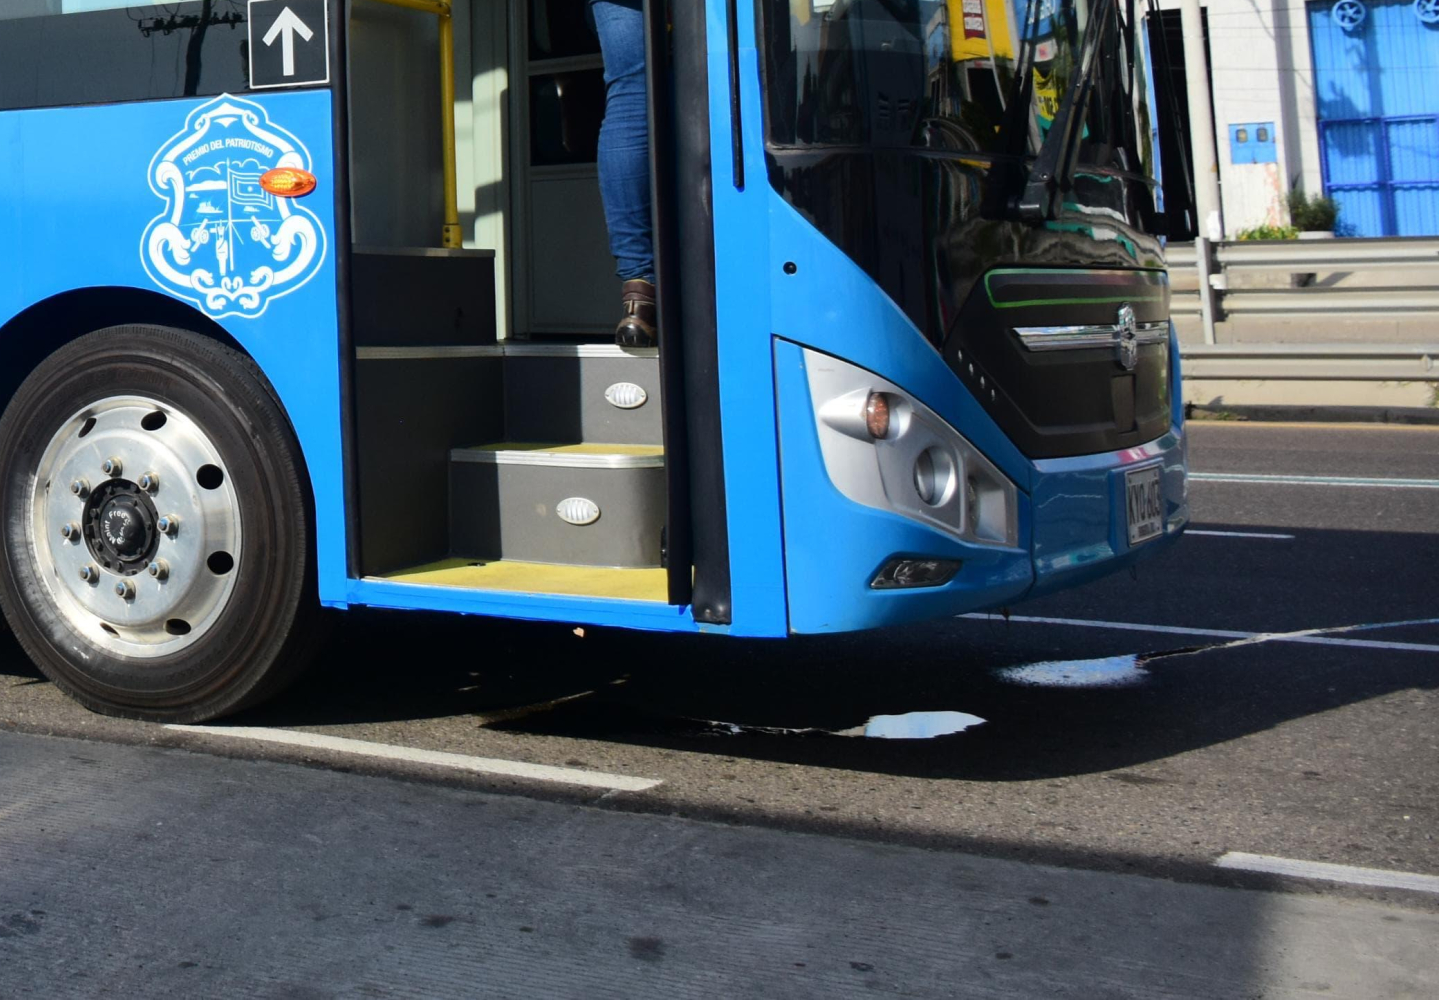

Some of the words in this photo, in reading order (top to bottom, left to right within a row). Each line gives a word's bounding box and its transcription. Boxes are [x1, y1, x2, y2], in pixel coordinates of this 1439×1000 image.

[182, 143, 210, 166] PREMIO
[209, 139, 225, 151] DEL
[225, 137, 274, 158] PATRIOTISMO
